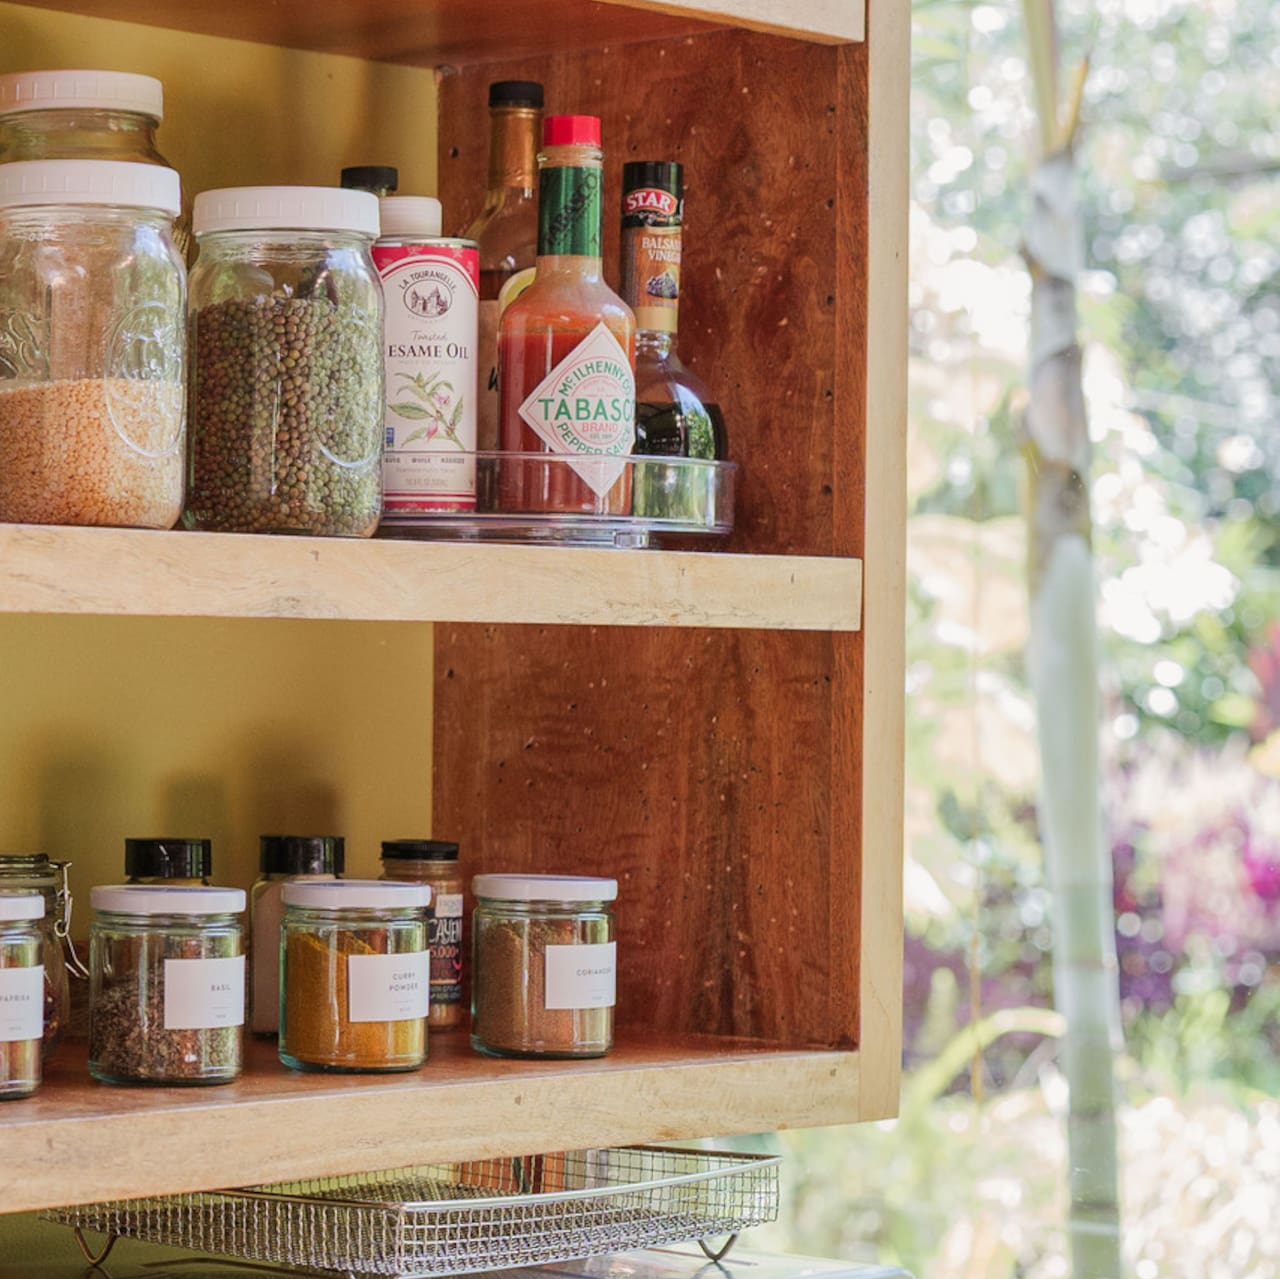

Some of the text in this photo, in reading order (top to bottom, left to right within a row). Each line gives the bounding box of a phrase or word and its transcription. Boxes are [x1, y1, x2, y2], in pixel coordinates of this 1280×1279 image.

[627, 191, 671, 212] STAR
[642, 237, 682, 250] BALSAM
[648, 250, 681, 263] VINEG
[399, 279, 410, 291] LA
[388, 344, 442, 358] ESAME
[537, 398, 635, 422] TABASC
[582, 422, 618, 433] BRAND
